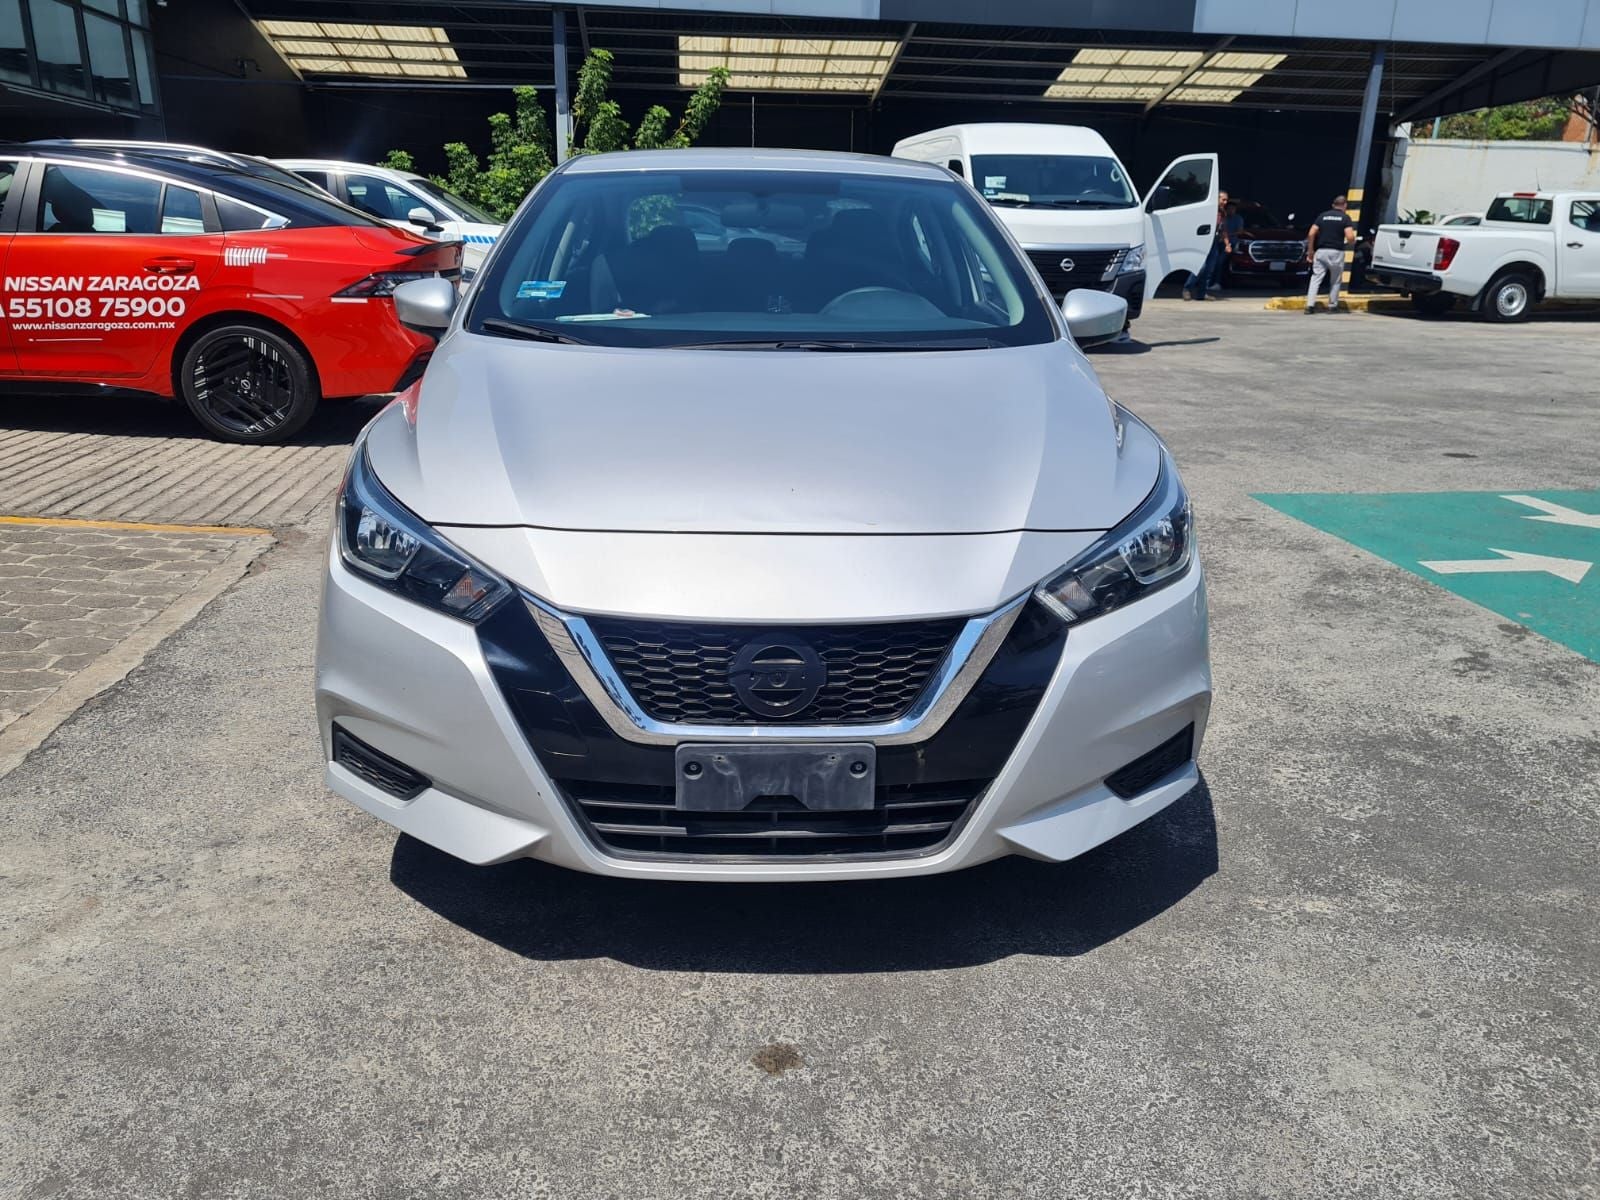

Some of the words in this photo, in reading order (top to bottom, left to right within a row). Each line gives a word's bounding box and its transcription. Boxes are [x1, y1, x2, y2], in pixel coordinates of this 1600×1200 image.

[4, 276, 84, 292] NISSAN
[86, 275, 201, 291] ZARAGOZA
[9, 297, 92, 318] 55108
[99, 297, 186, 318] 75900
[12, 320, 176, 332] www.nissanzaragoza.com.mx
